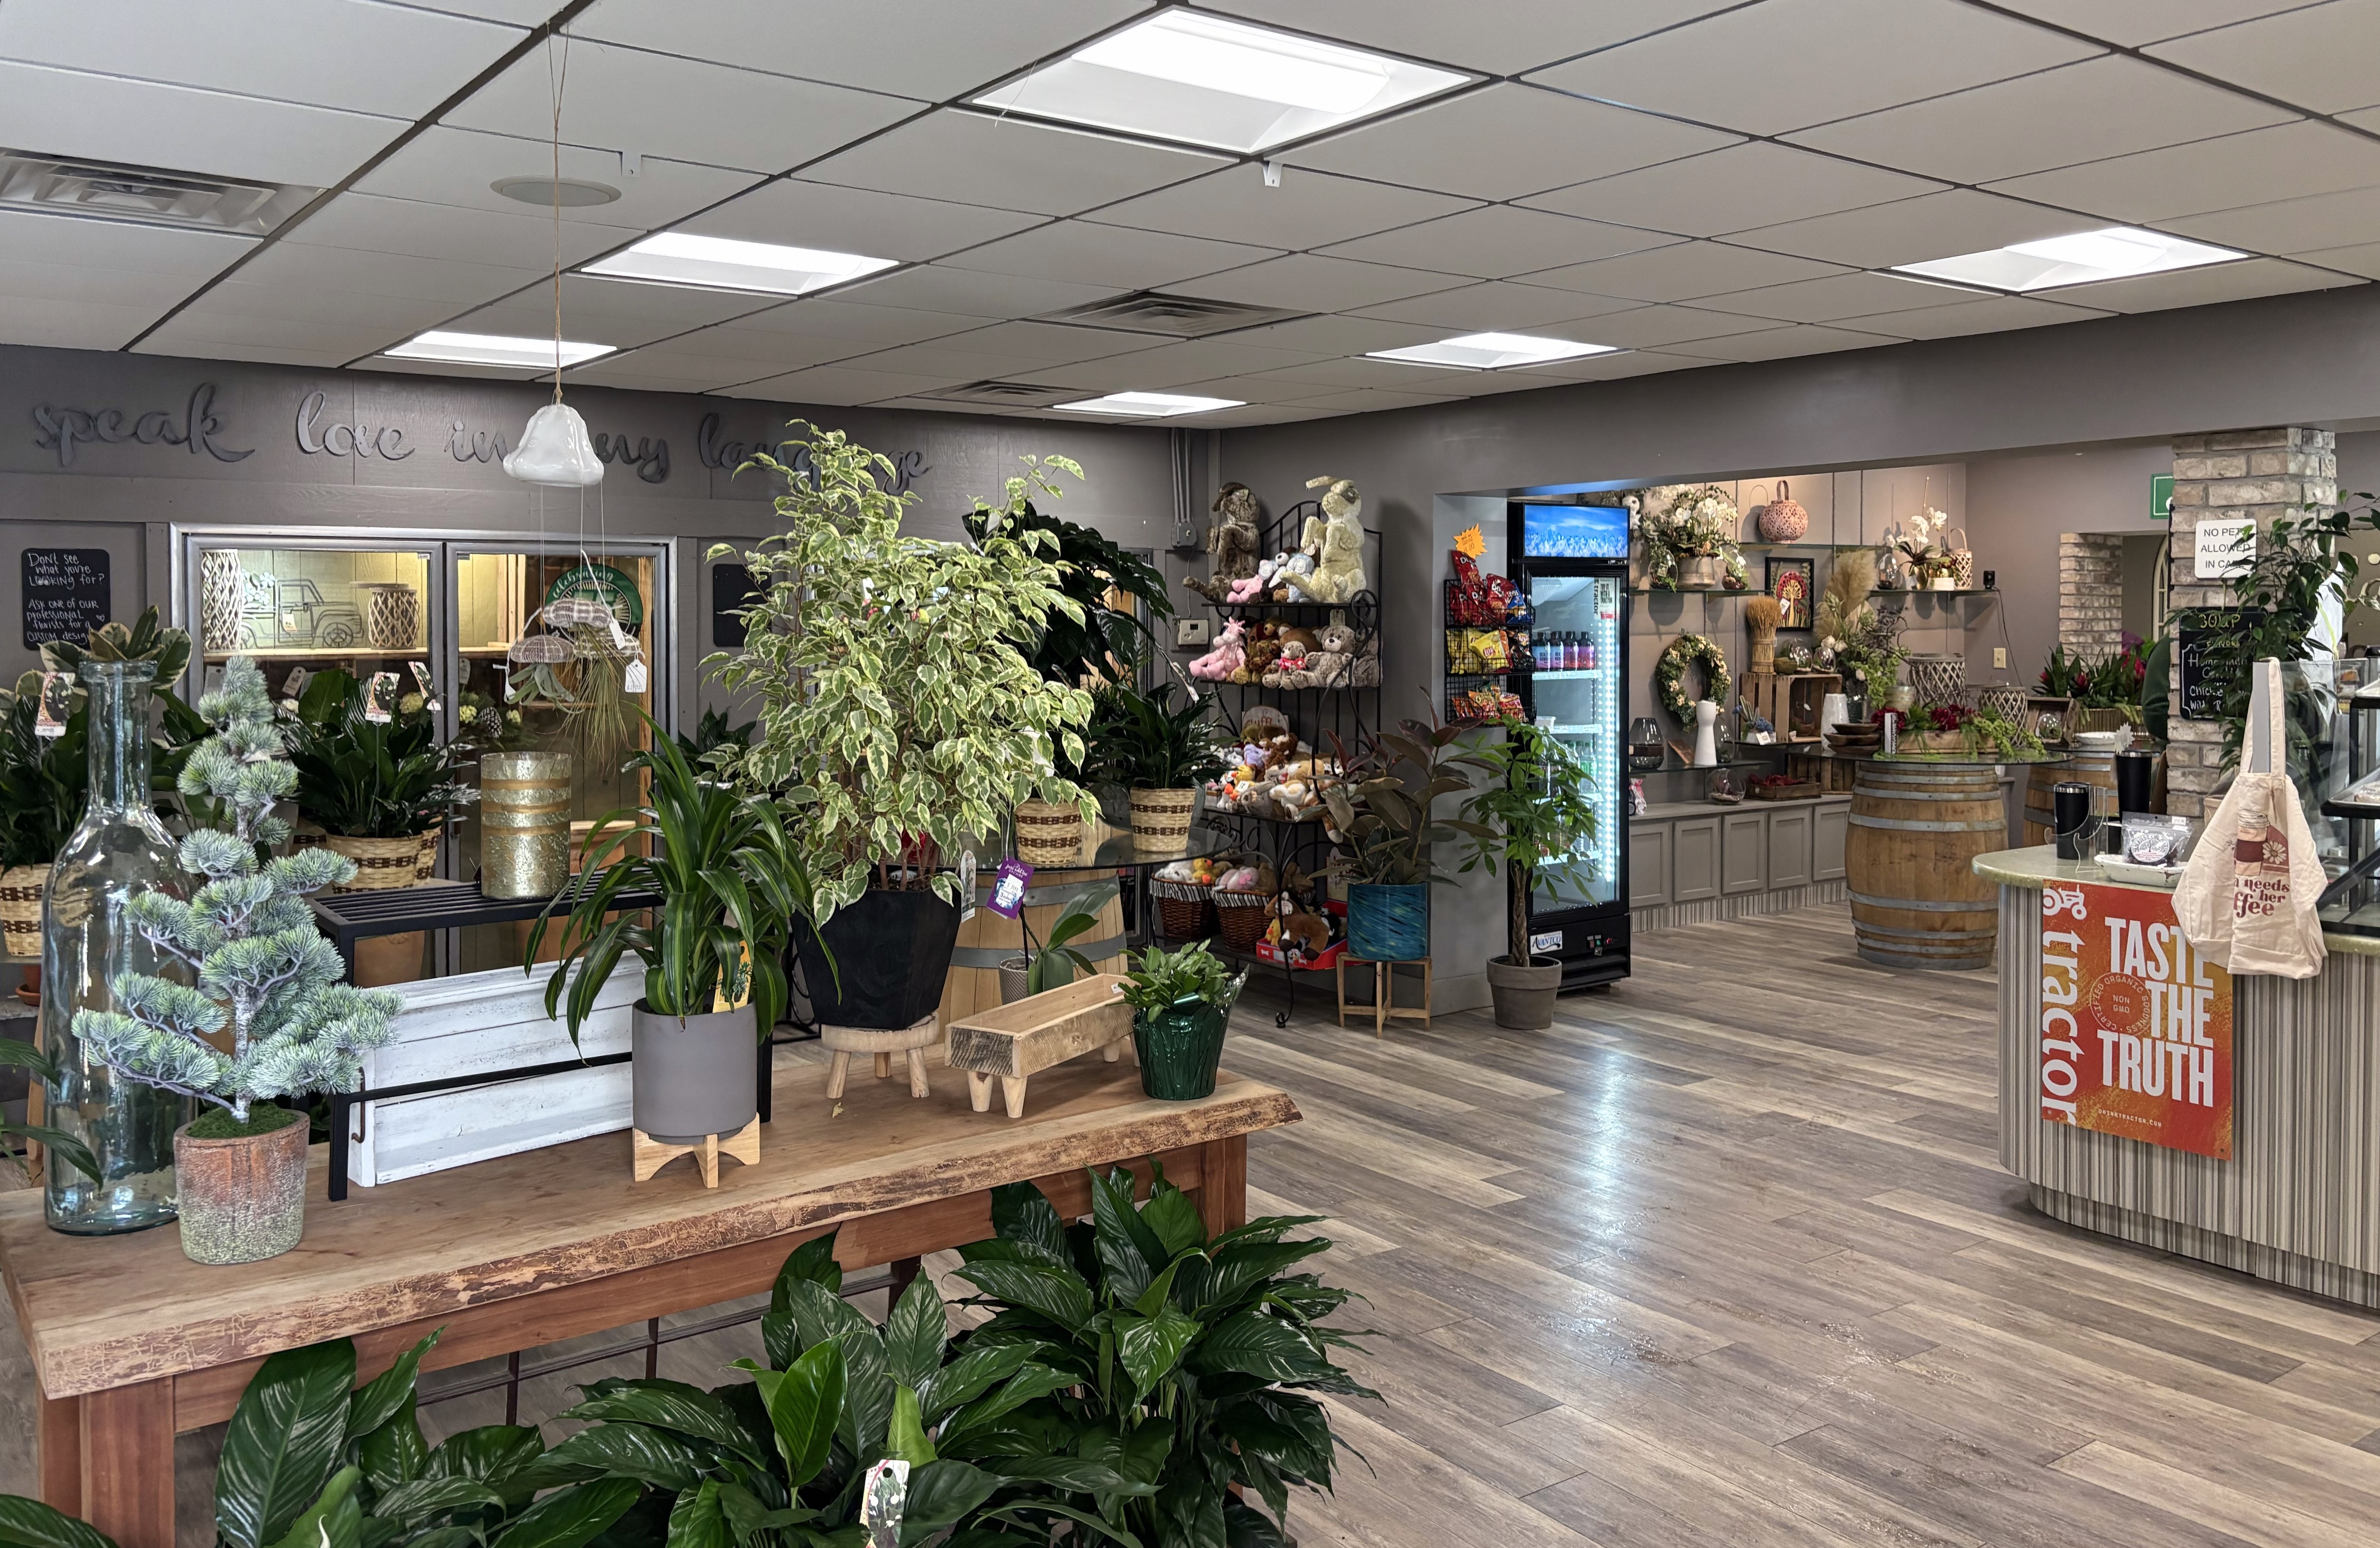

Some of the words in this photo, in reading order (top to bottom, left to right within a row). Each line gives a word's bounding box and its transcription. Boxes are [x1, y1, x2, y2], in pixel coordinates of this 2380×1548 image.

[34, 382, 256, 467] speak
[297, 391, 415, 461] love
[595, 432, 670, 484] ny
[700, 412, 933, 496] langge
[2204, 528, 2219, 537] NO
[2222, 527, 2242, 537] PET
[2201, 543, 2251, 553] ALLOWED
[63, 554, 79, 564] see
[2206, 560, 2215, 568] IN
[36, 565, 59, 574] what
[67, 597, 76, 609] of
[79, 600, 99, 609] OUR
[62, 631, 89, 645] desig
[2244, 879, 2290, 893] needs
[2259, 889, 2286, 903] her
[2233, 892, 2275, 918] ffee
[2104, 975, 2143, 993] ORGANIC
[2113, 995, 2130, 1004] NON
[2093, 983, 2117, 1031] CERTIFIED
[2113, 1005, 2130, 1014] GMO
[2126, 995, 2150, 1033] GOODNESS
[2145, 980, 2213, 1047] THE
[2042, 929, 2085, 1126] tractor
[2097, 1029, 2213, 1108] TRUTH
[2098, 1108, 2162, 1127] DRINKTRACTOR.COM
